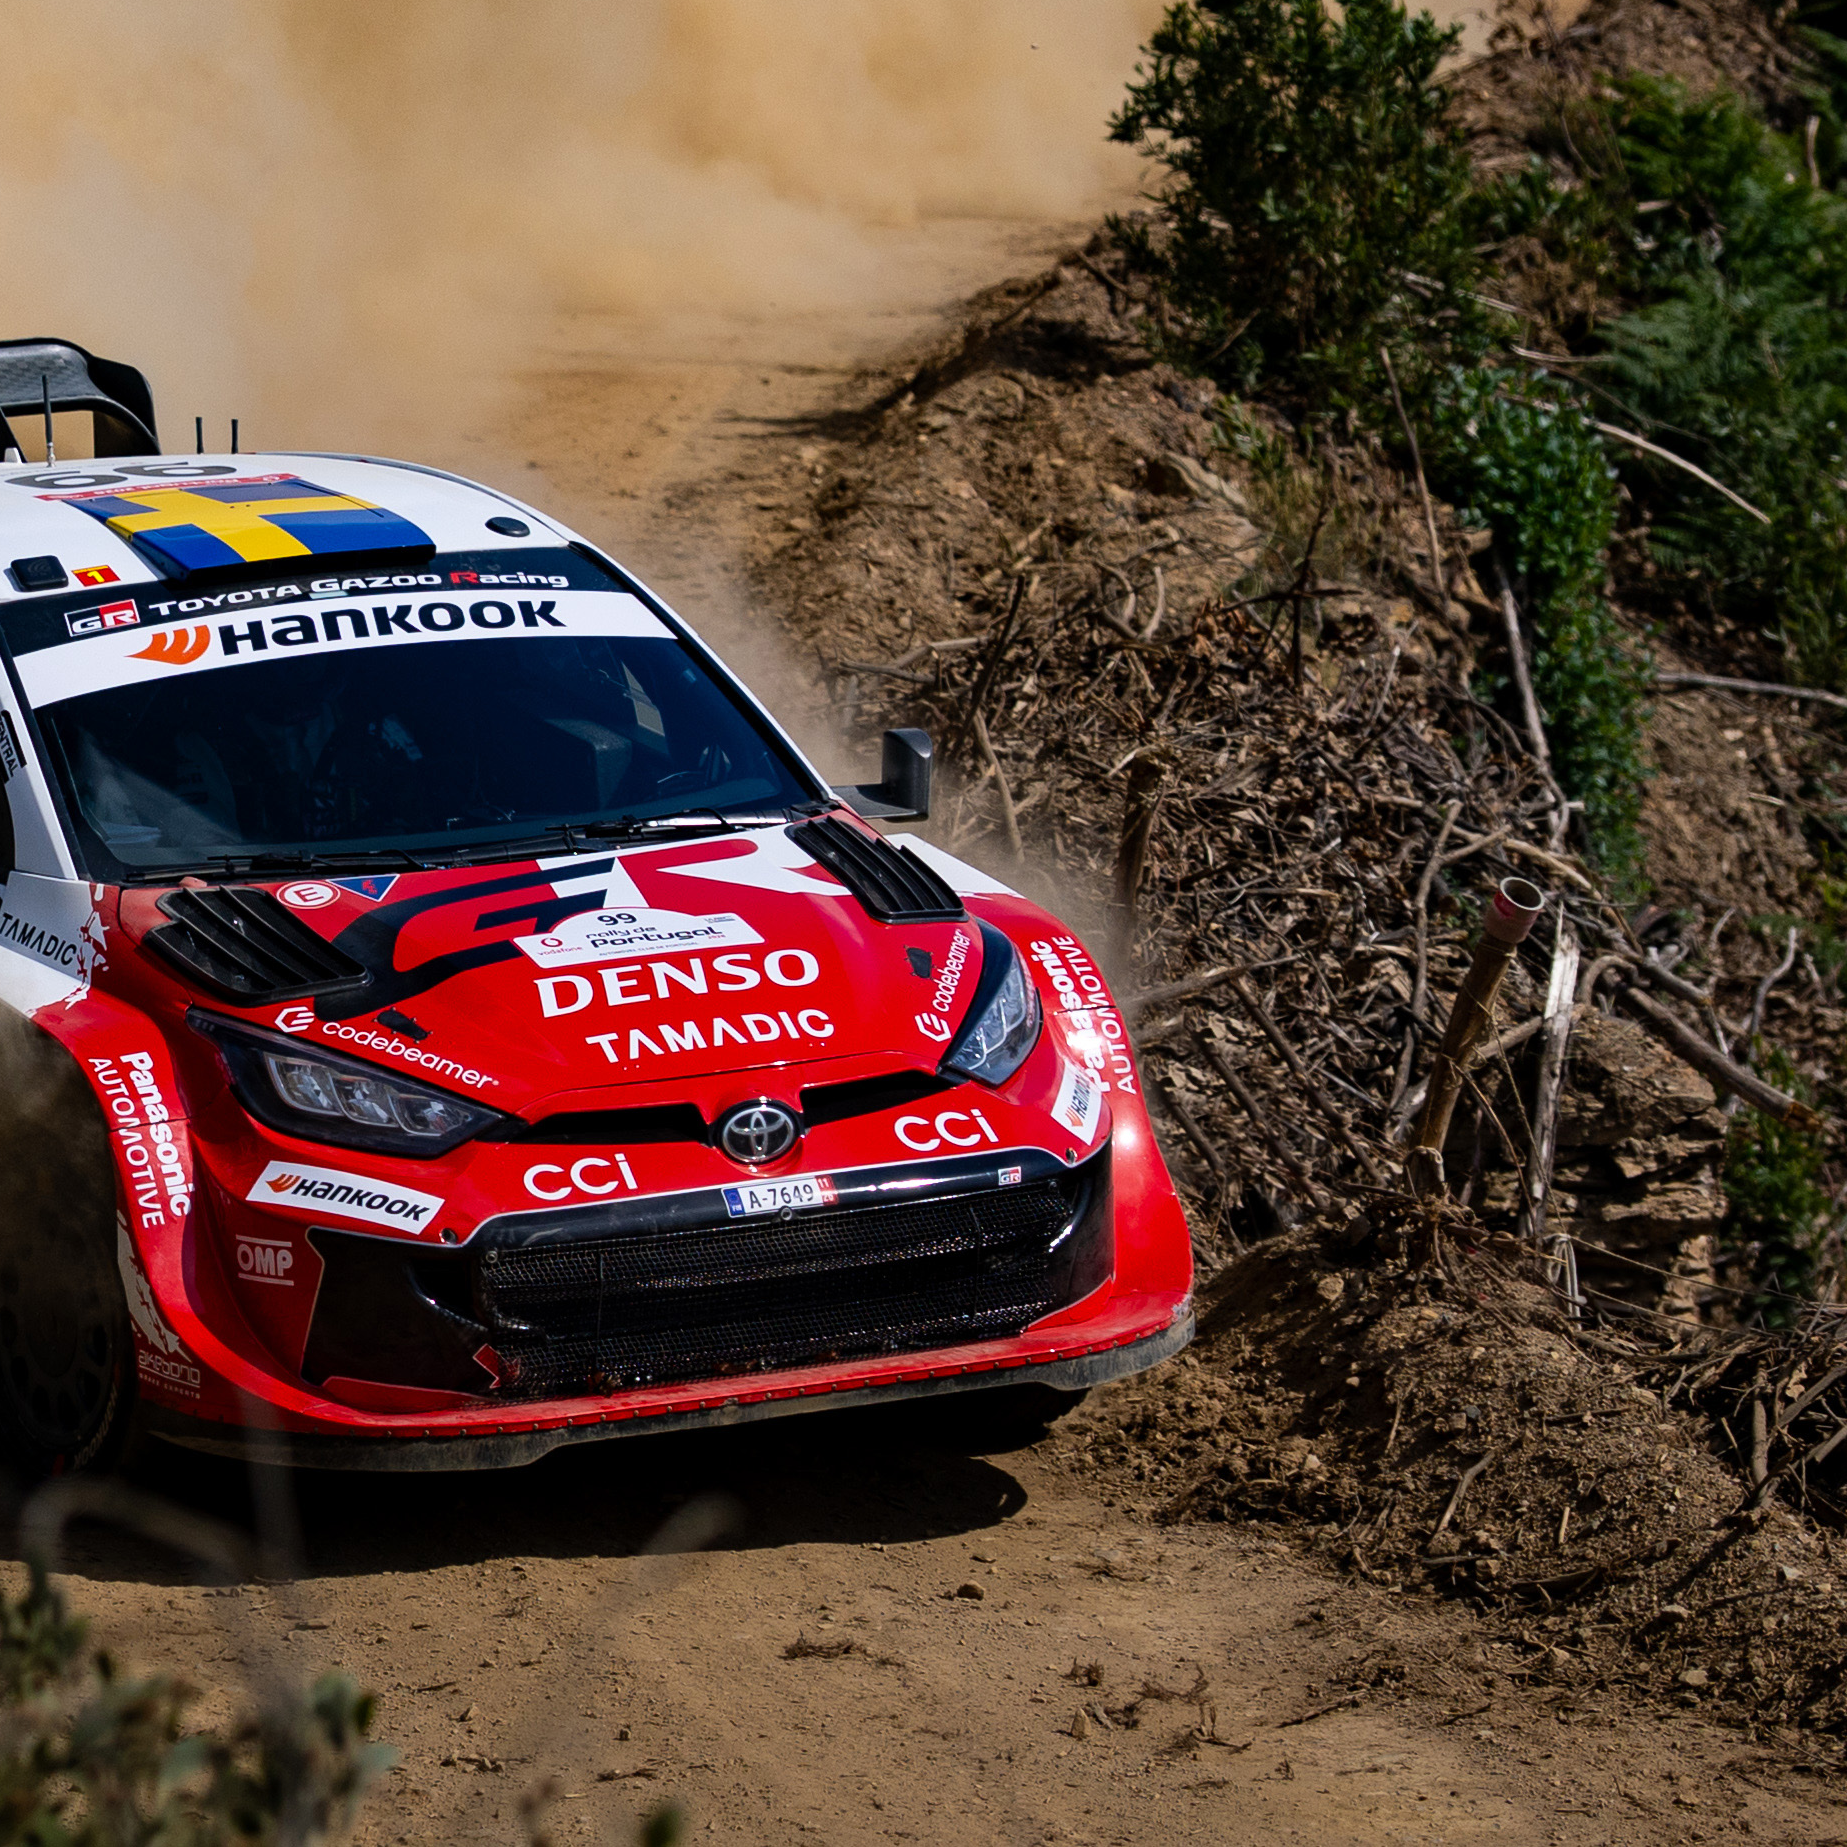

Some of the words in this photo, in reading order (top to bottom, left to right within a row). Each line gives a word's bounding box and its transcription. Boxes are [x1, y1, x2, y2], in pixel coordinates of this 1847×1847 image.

[70, 609, 138, 634] GR
[148, 584, 302, 616] TOYOTA
[311, 573, 442, 594] GAZOO
[449, 571, 569, 588] Racing
[87, 570, 105, 584] 1
[586, 926, 633, 939] rally
[635, 926, 657, 934] de
[590, 926, 724, 948] Portugal
[597, 912, 638, 926] 99
[537, 945, 583, 956] vodafone
[932, 929, 971, 1013] codebeamer
[533, 949, 820, 1018] DENSO
[585, 1009, 835, 1064] TAMADIC
[1030, 939, 1111, 1092] Panasonic
[1052, 935, 1137, 1095] AUTOMOTIVE
[322, 1021, 494, 1089] codebeamer
[88, 1056, 165, 1229] AUTOMOTIVE
[120, 1051, 195, 1218] Panasonic
[749, 1184, 814, 1209] A-7649
[817, 1178, 829, 1188] 11
[236, 1243, 294, 1277] OMP
